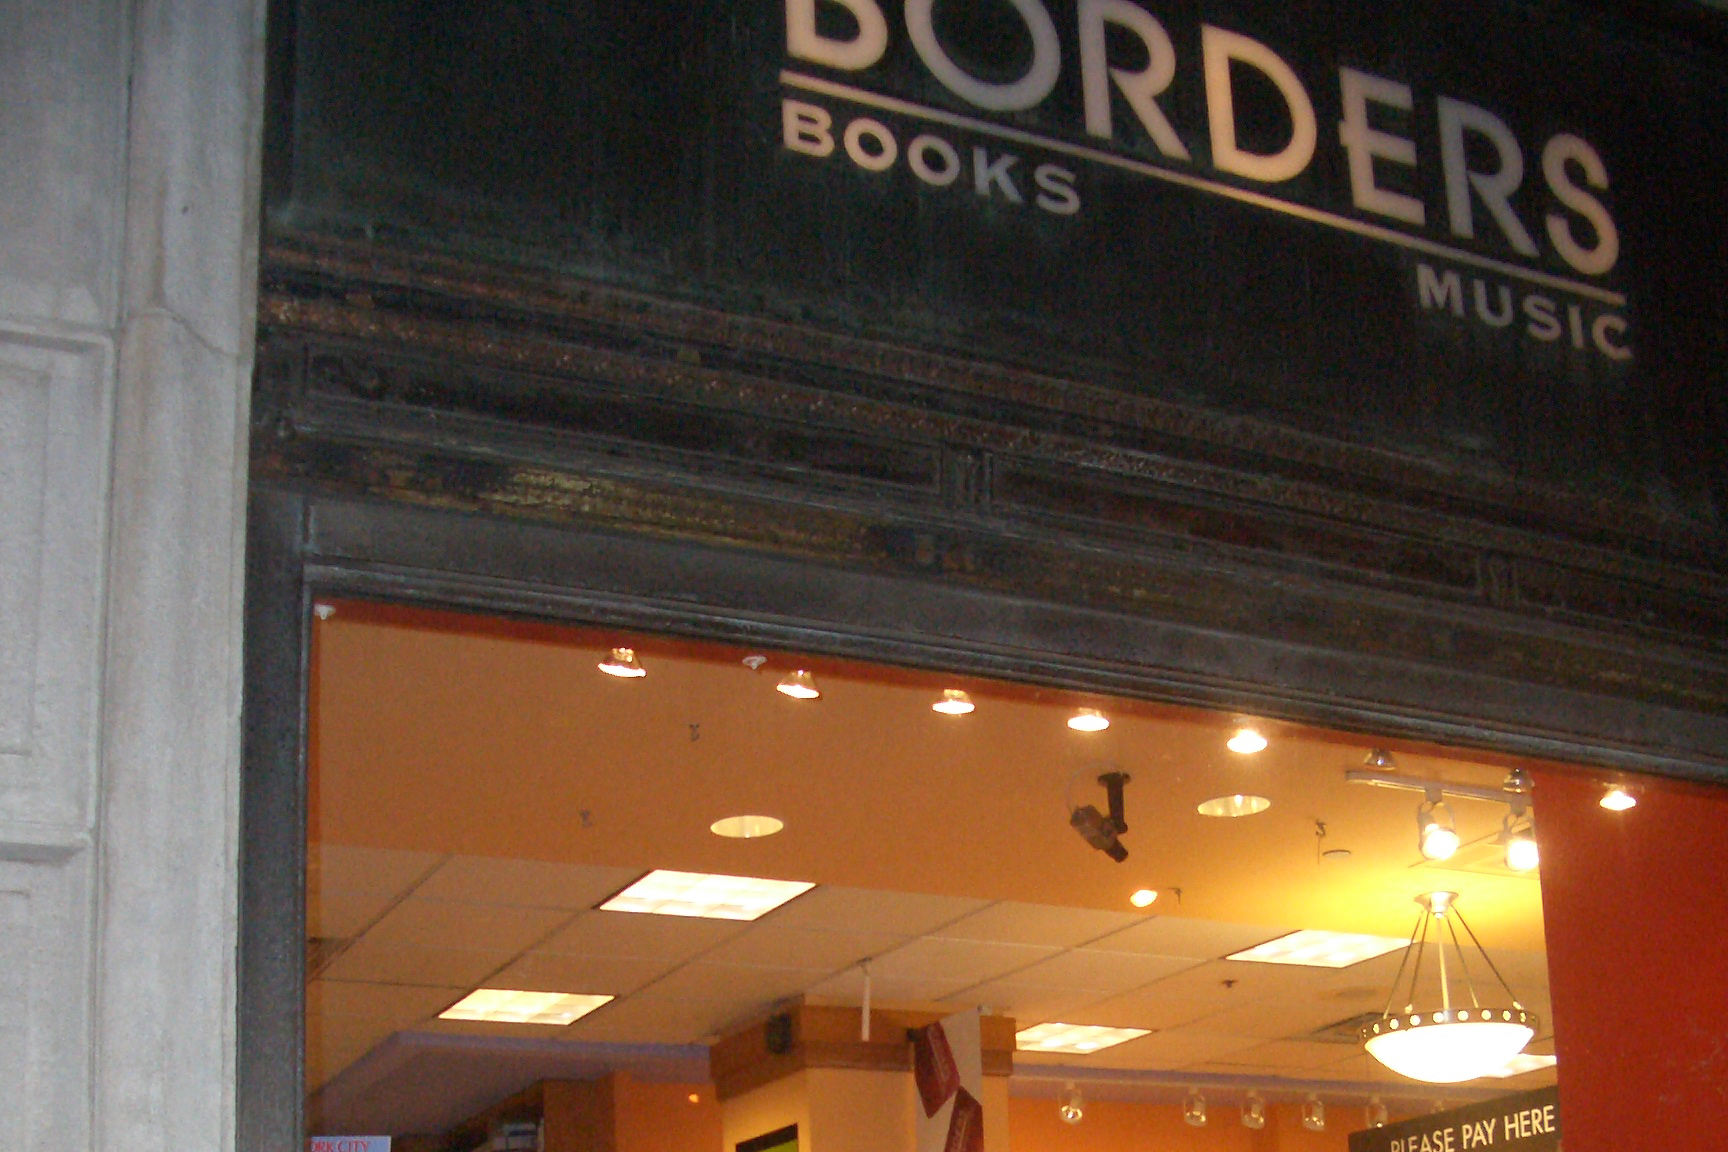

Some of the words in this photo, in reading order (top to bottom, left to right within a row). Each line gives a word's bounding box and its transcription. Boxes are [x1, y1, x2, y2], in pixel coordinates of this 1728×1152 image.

[782, 97, 1081, 216] BOOKS
[1416, 262, 1634, 361] MUSIC
[1461, 1118, 1496, 1151] PAY
[1504, 1104, 1556, 1142] HERE
